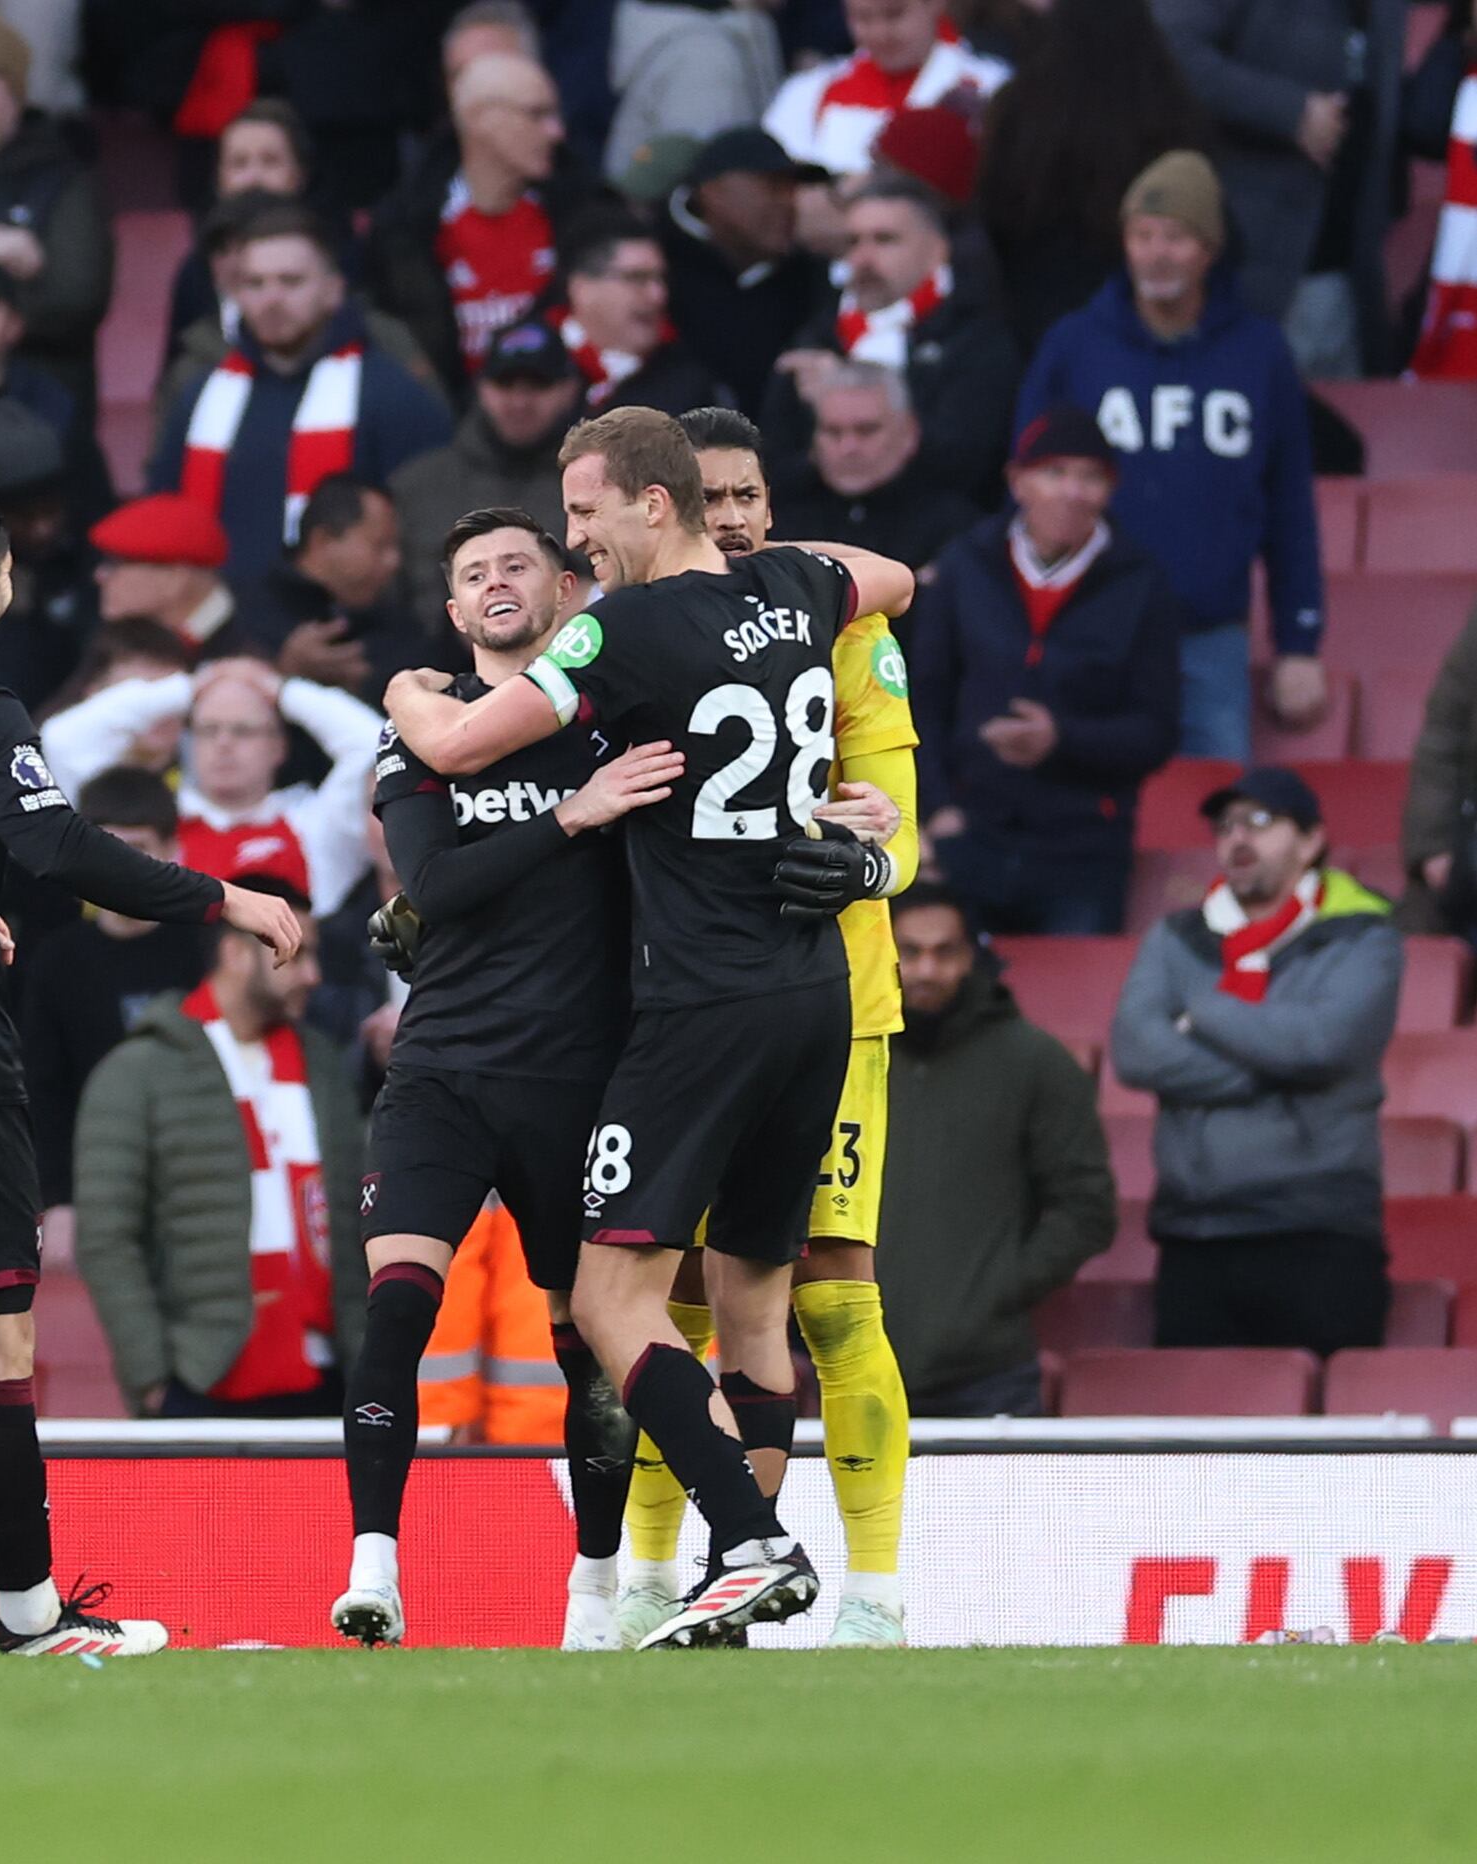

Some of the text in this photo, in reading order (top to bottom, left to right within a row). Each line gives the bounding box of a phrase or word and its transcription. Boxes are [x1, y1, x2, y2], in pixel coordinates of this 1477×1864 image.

[1096, 384, 1252, 458] AFC
[687, 666, 836, 840] 28
[449, 781, 578, 827] betw
